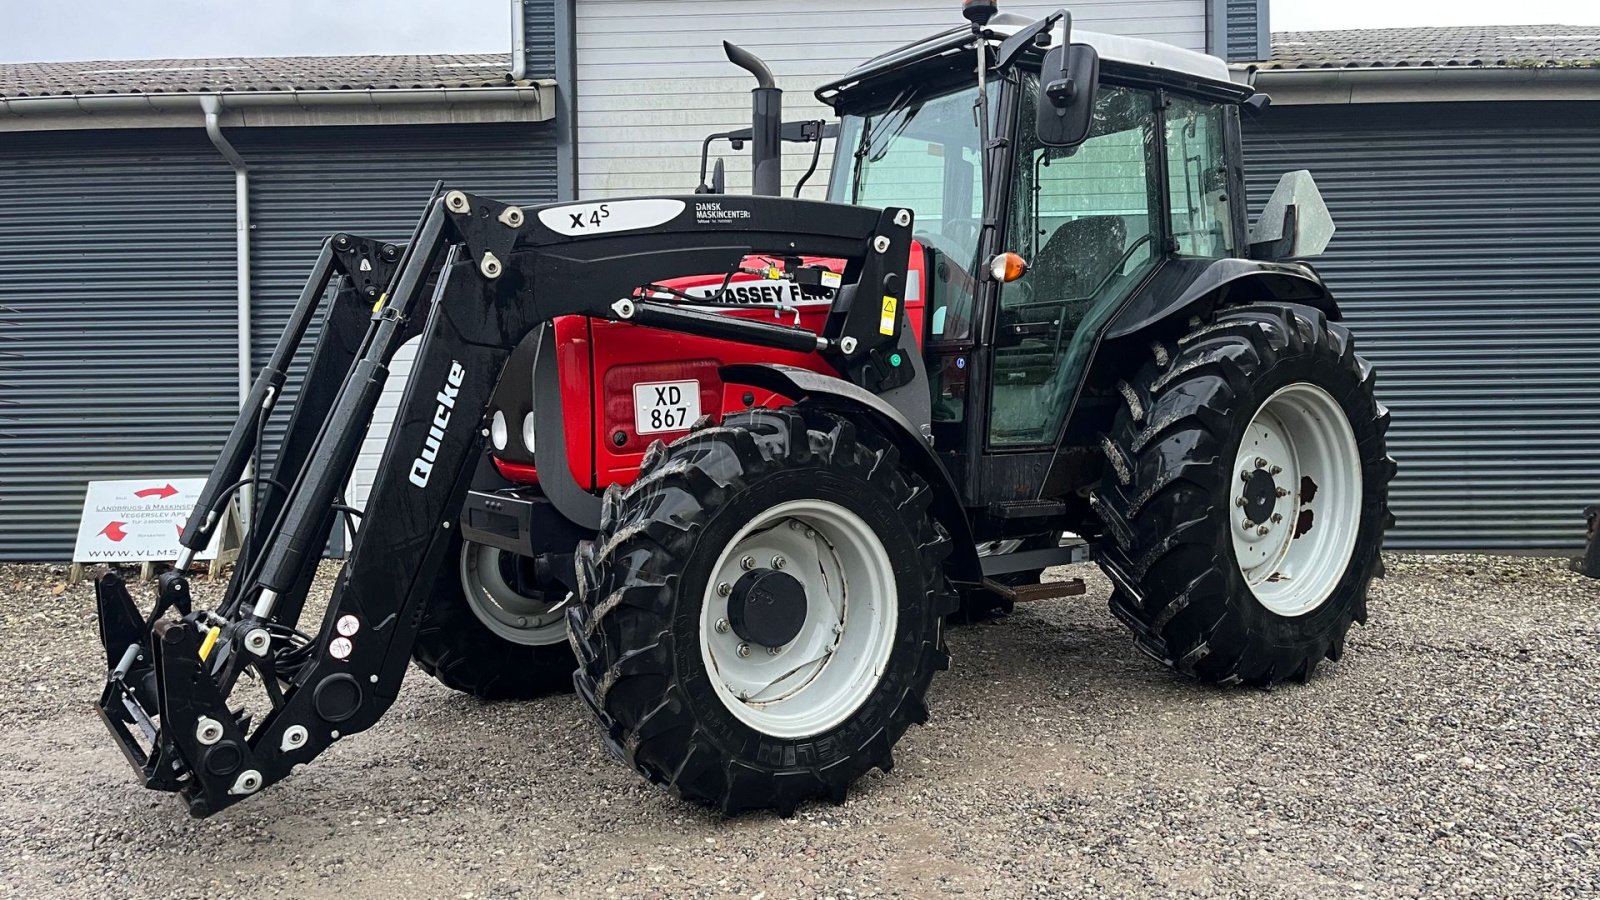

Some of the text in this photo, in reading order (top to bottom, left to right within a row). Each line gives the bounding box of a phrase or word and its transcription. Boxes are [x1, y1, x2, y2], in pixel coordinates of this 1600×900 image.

[696, 202, 721, 211] DANSK
[704, 285, 783, 304] MASSEY
[655, 386, 681, 406] XD
[651, 407, 686, 429] 867
